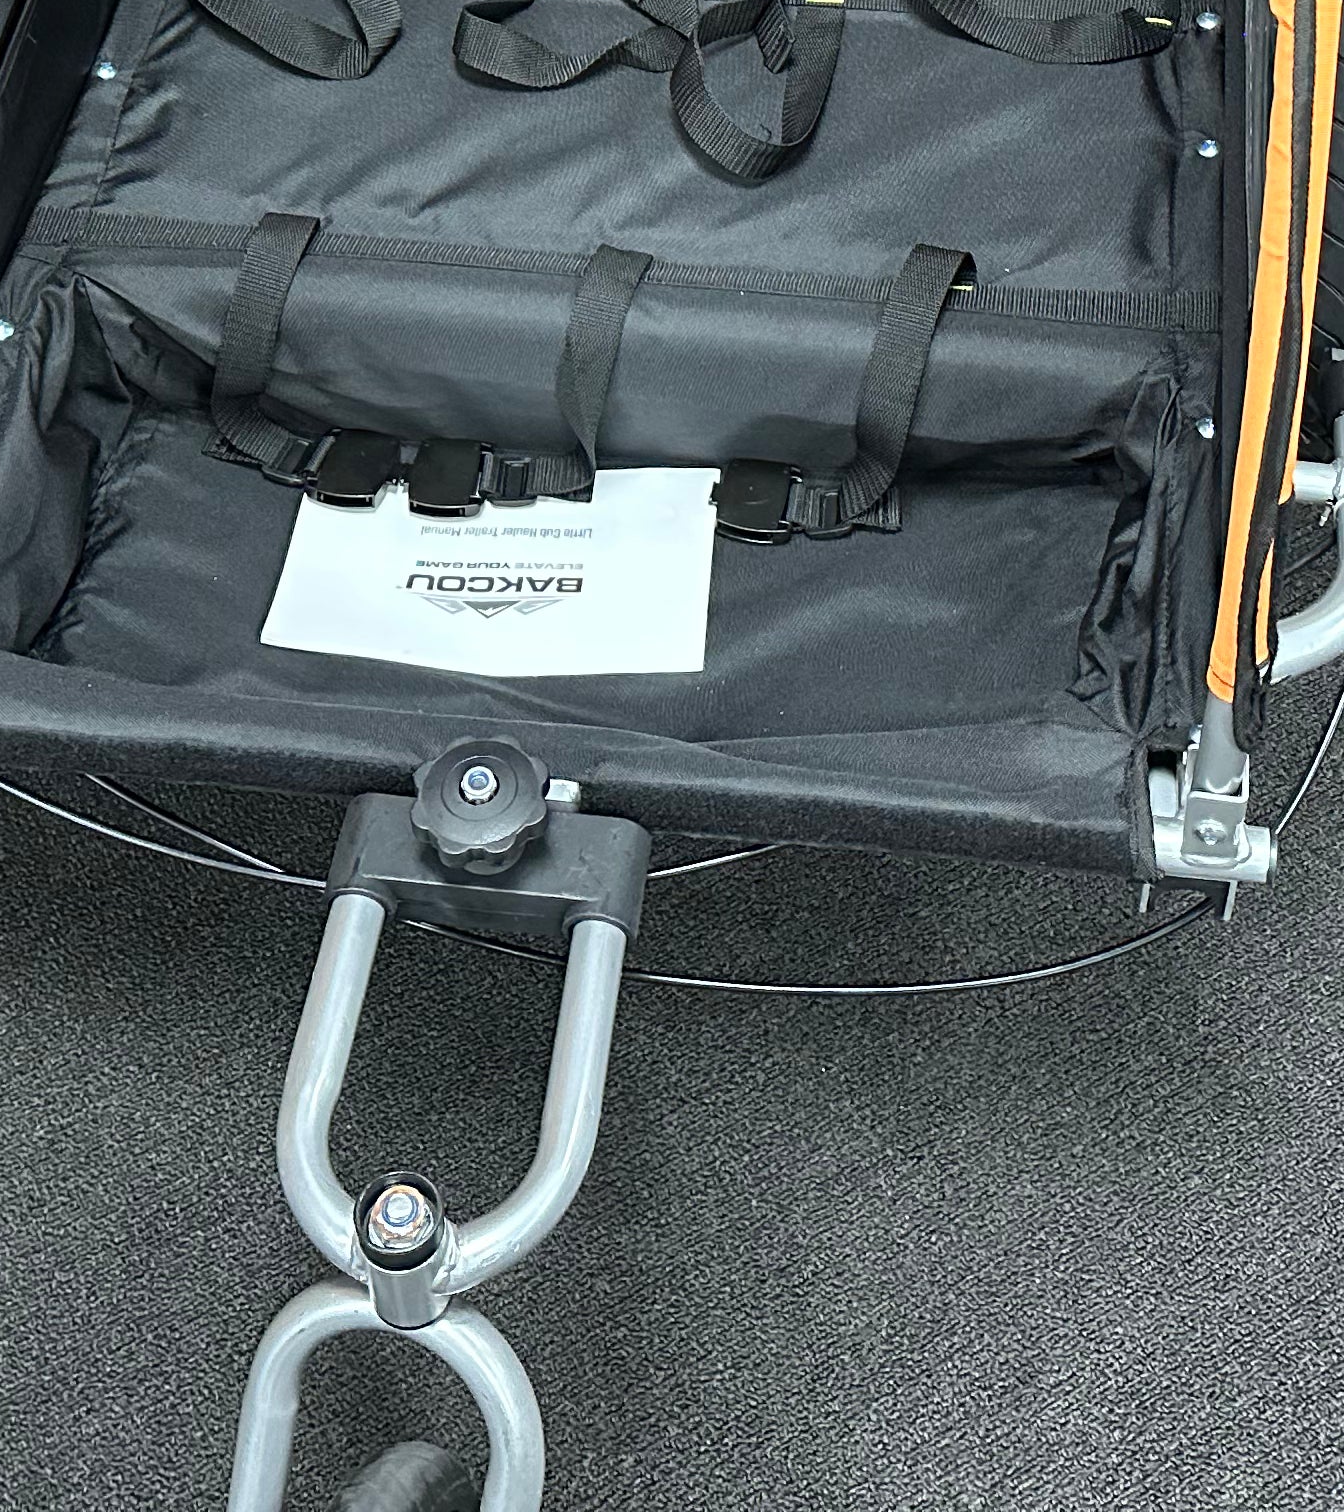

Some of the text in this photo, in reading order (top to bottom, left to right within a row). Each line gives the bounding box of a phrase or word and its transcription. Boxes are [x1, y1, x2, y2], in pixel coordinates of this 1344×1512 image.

[420, 524, 593, 539] Little Cub Hauler Trailer Manual
[415, 559, 584, 570] ELEVATE YOUR GAME
[406, 573, 584, 593] BAKCOU
